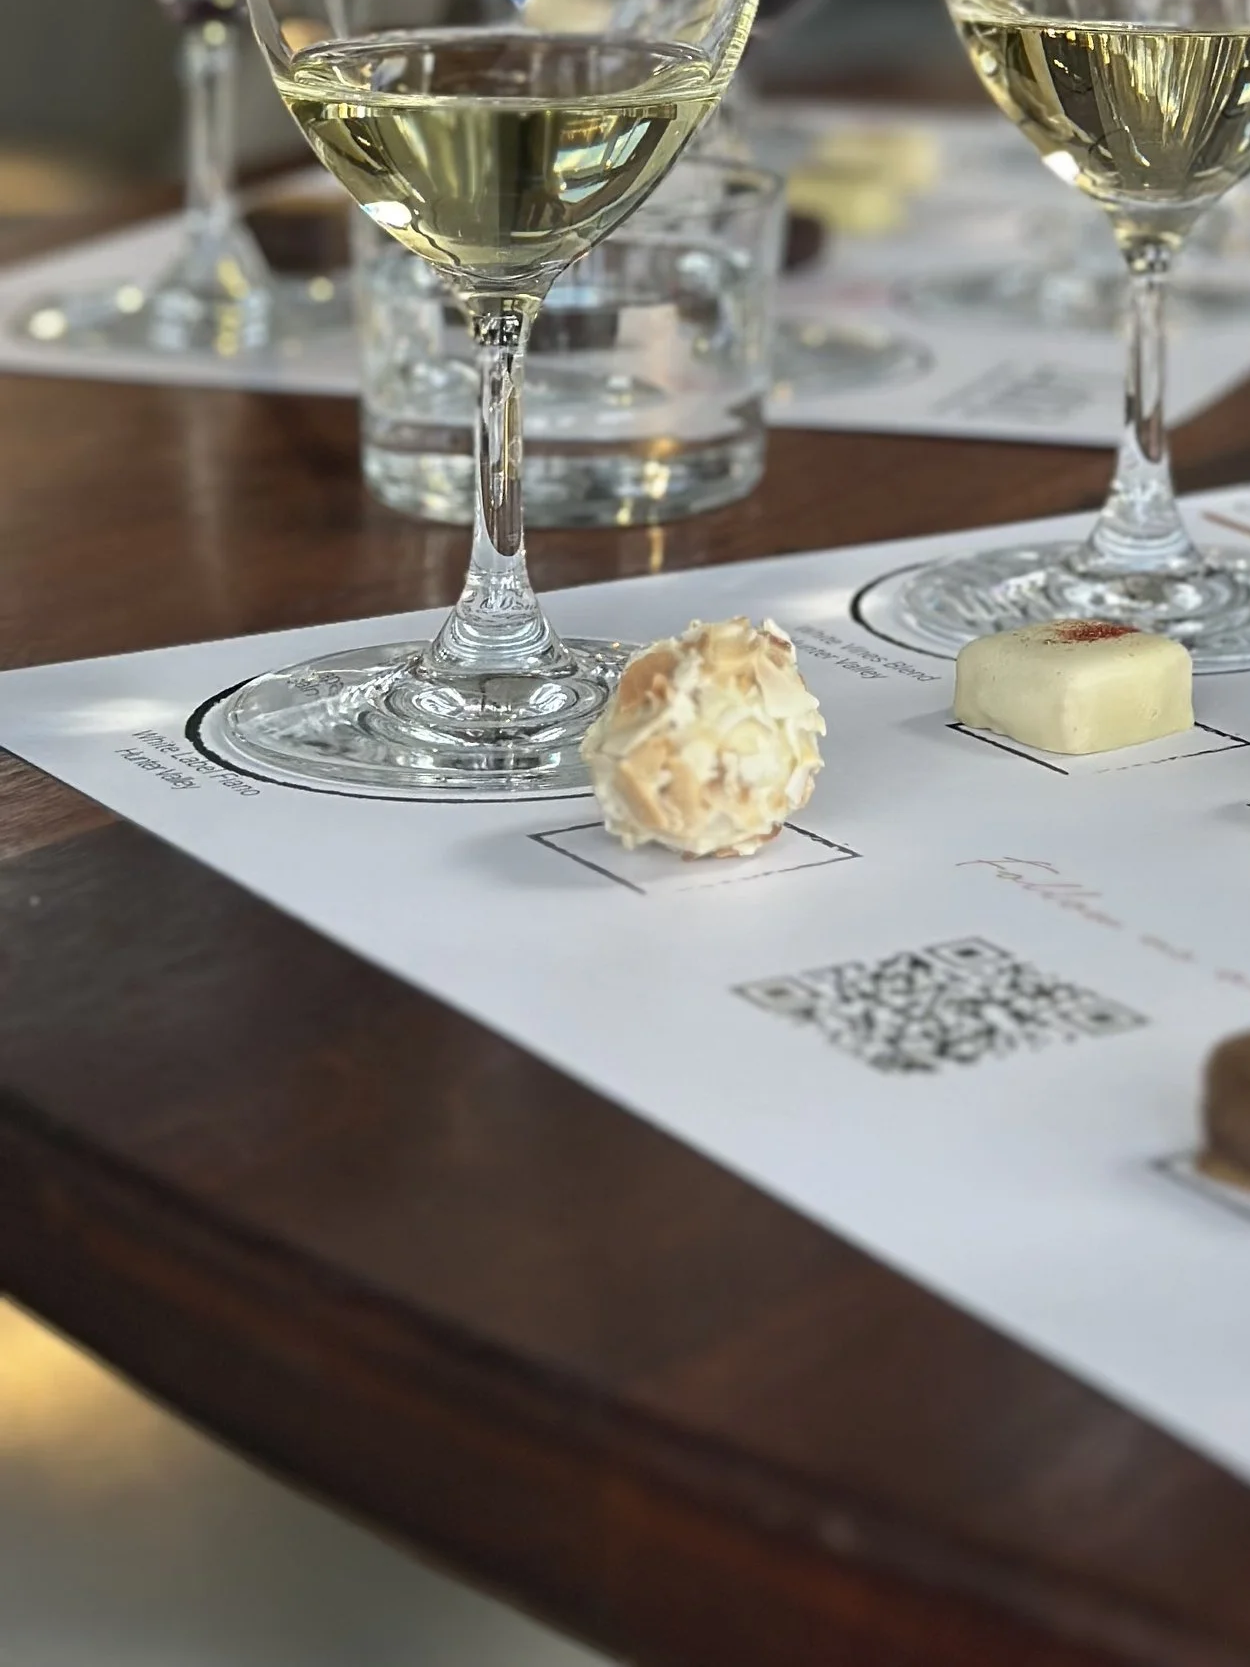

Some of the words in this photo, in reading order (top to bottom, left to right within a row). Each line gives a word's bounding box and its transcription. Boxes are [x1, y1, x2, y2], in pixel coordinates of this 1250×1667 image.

[835, 657, 888, 679] Valley
[884, 660, 943, 682] Blend
[114, 747, 168, 771] Hunter
[154, 768, 202, 790] Valley
[131, 729, 180, 753] White
[170, 750, 228, 775] Label
[209, 773, 260, 796] Fiano
